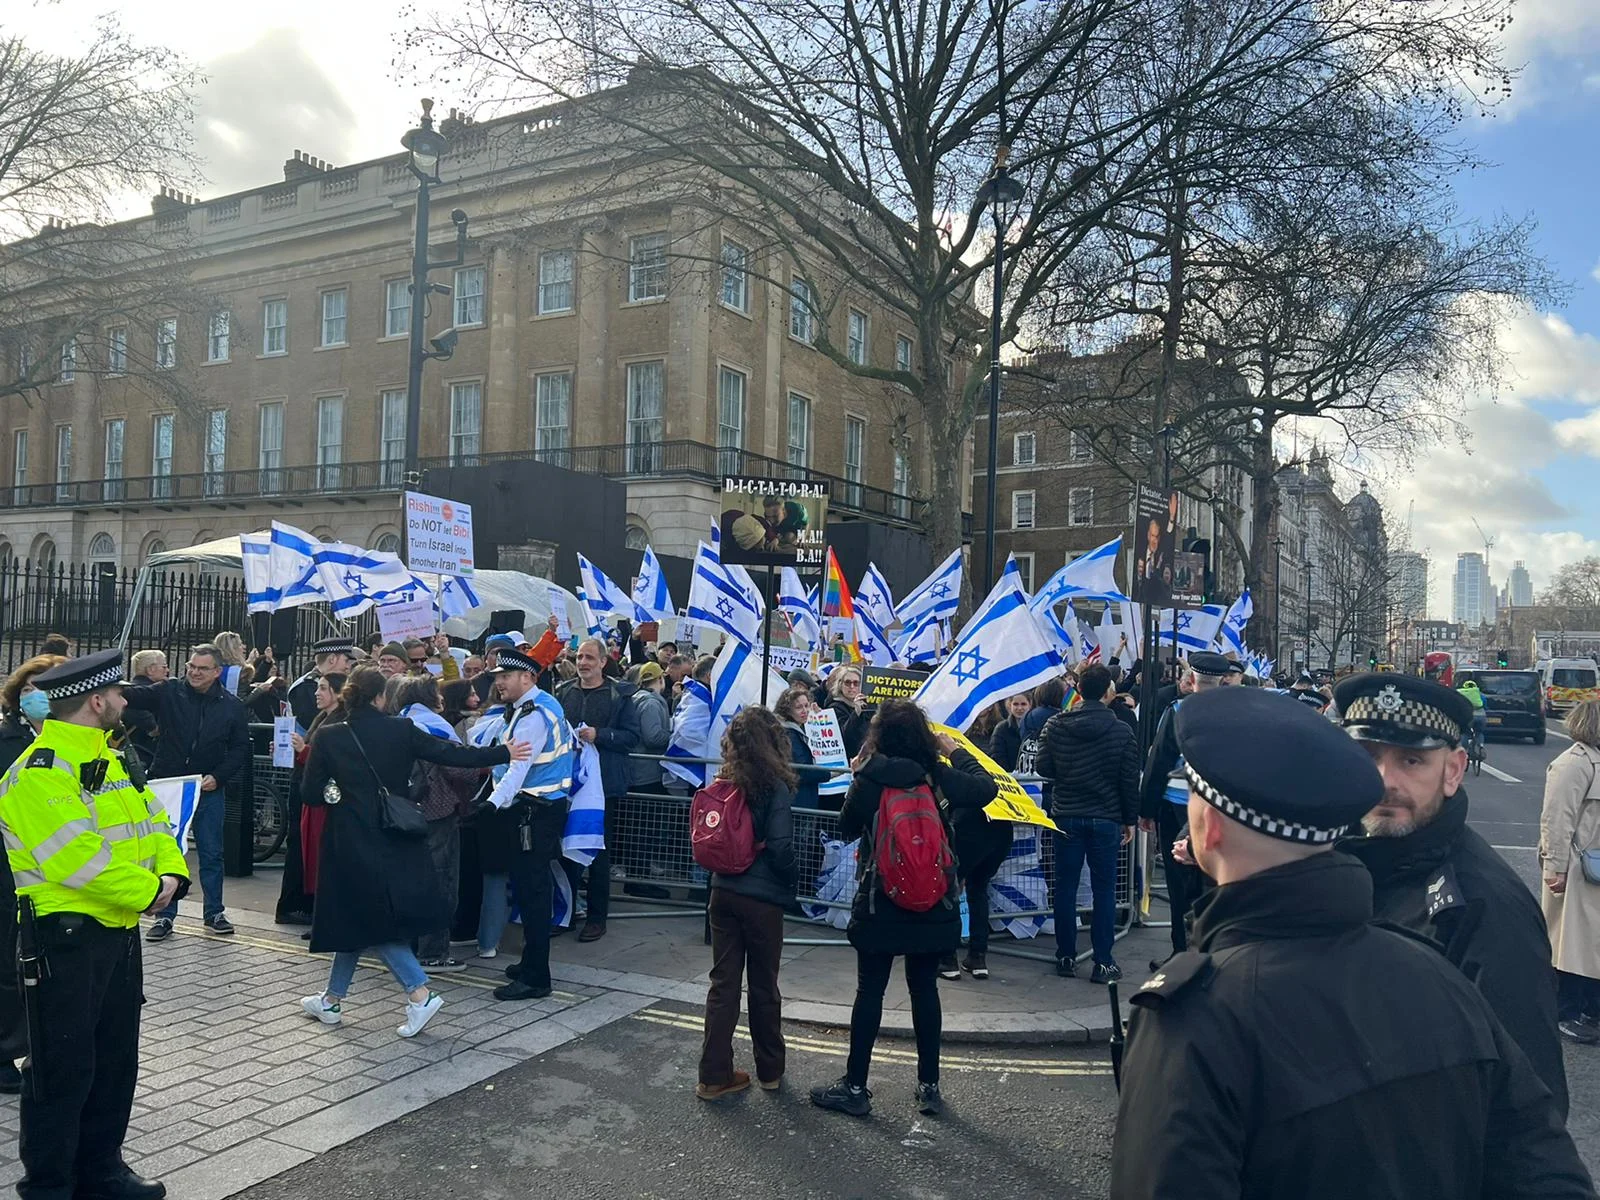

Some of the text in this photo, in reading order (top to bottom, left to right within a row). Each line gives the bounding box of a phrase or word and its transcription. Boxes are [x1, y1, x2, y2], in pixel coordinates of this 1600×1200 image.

[409, 519, 469, 538] Do NOT let Bibi
[796, 529, 824, 544] M.A!!
[410, 537, 467, 555] Turn Israel into
[796, 548, 823, 563] B.A!!
[410, 557, 457, 571] another Iran
[866, 675, 923, 689] DICTATORS
[873, 686, 916, 697] ARE NOT
[820, 728, 833, 738] NO
